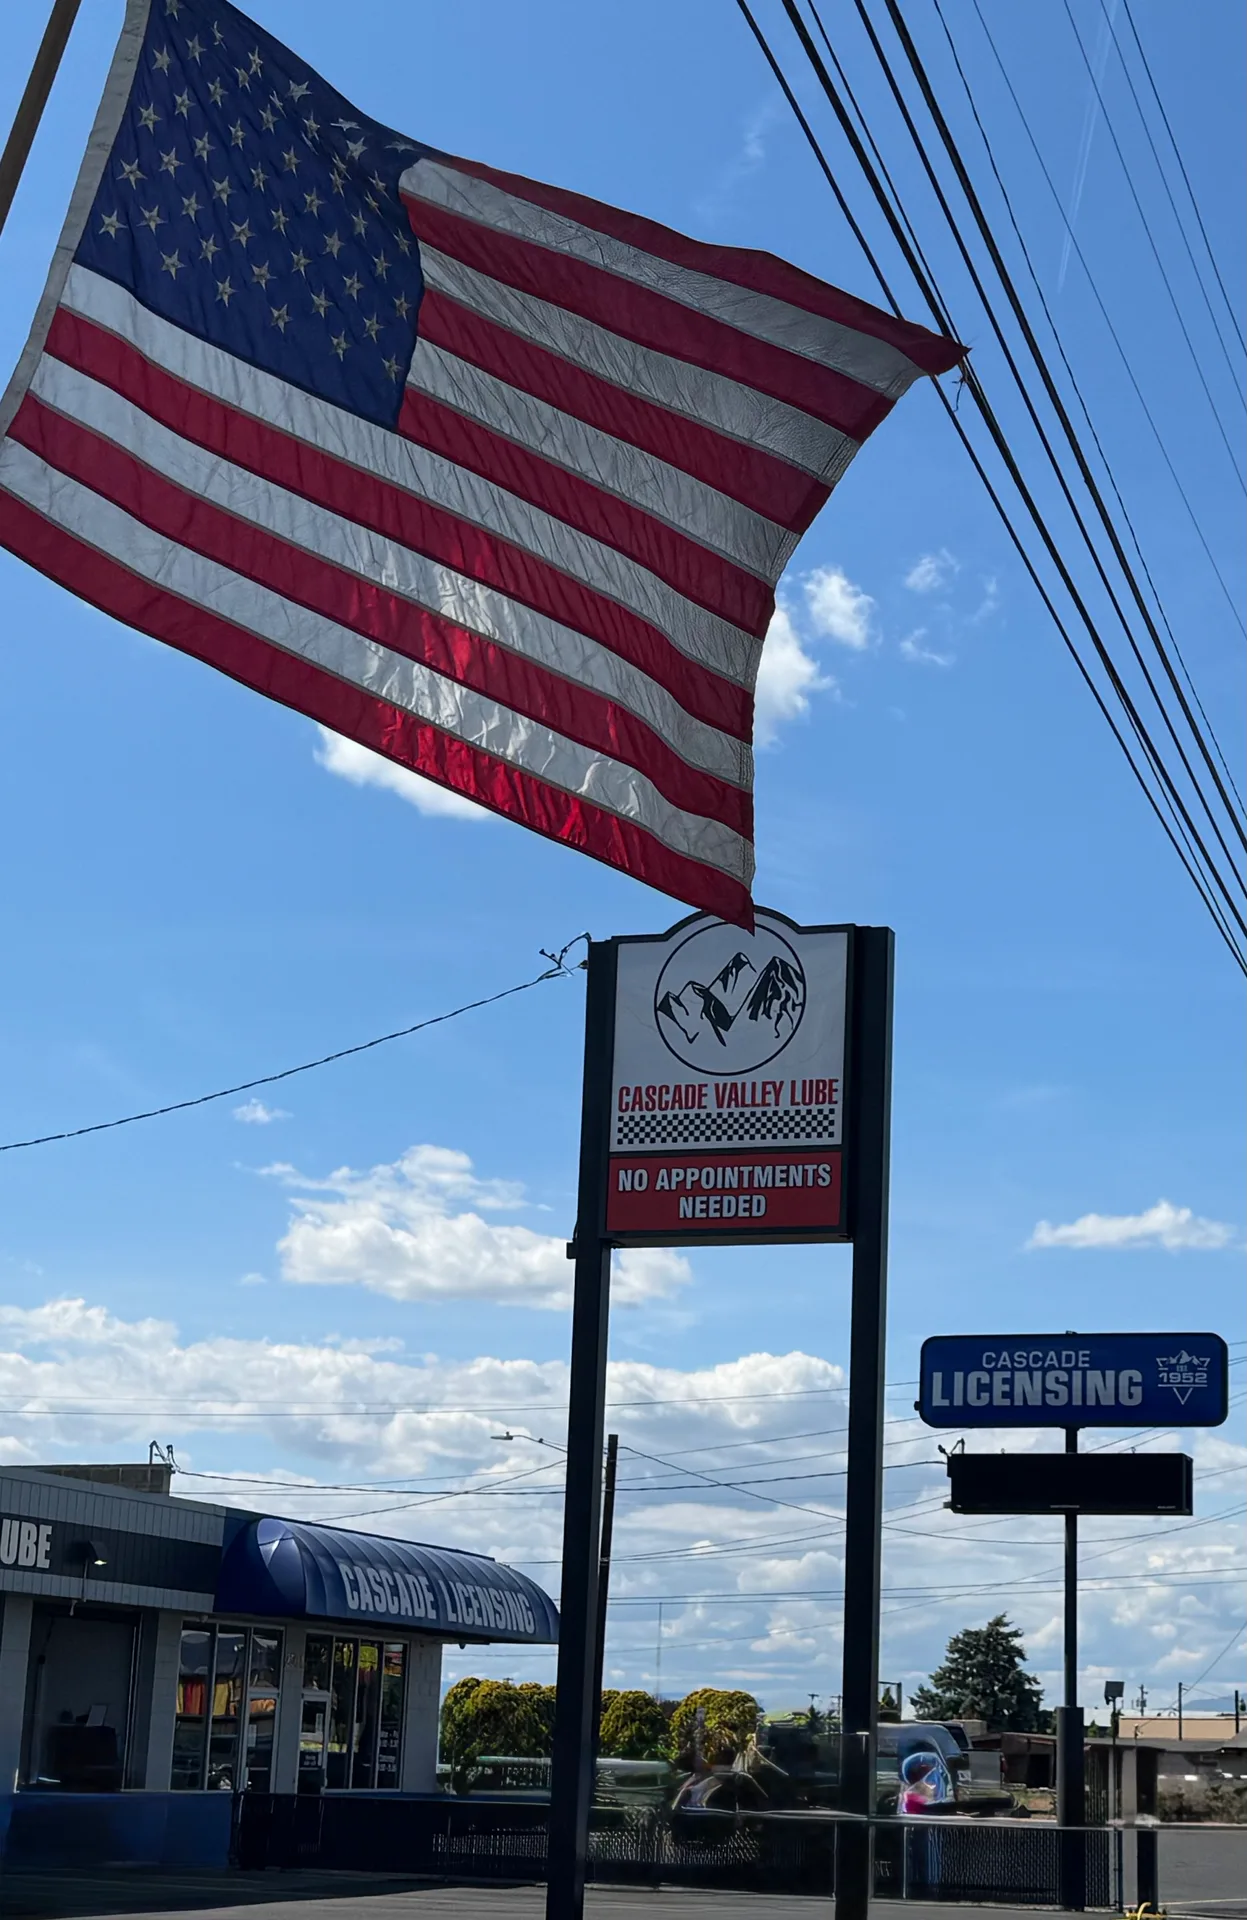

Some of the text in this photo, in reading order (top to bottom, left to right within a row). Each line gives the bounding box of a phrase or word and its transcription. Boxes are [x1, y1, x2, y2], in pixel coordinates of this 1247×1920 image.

[618, 1078, 839, 1112] CASCADE VALLEY LUBE
[618, 1163, 831, 1191] NO APPOINTMENTS
[679, 1194, 766, 1218] NEEDED
[982, 1350, 1090, 1368] CASCADE
[932, 1369, 1143, 1407] LICENSING
[1159, 1372, 1208, 1383] 1952
[338, 1563, 536, 1634] CASCADE LICENSING
